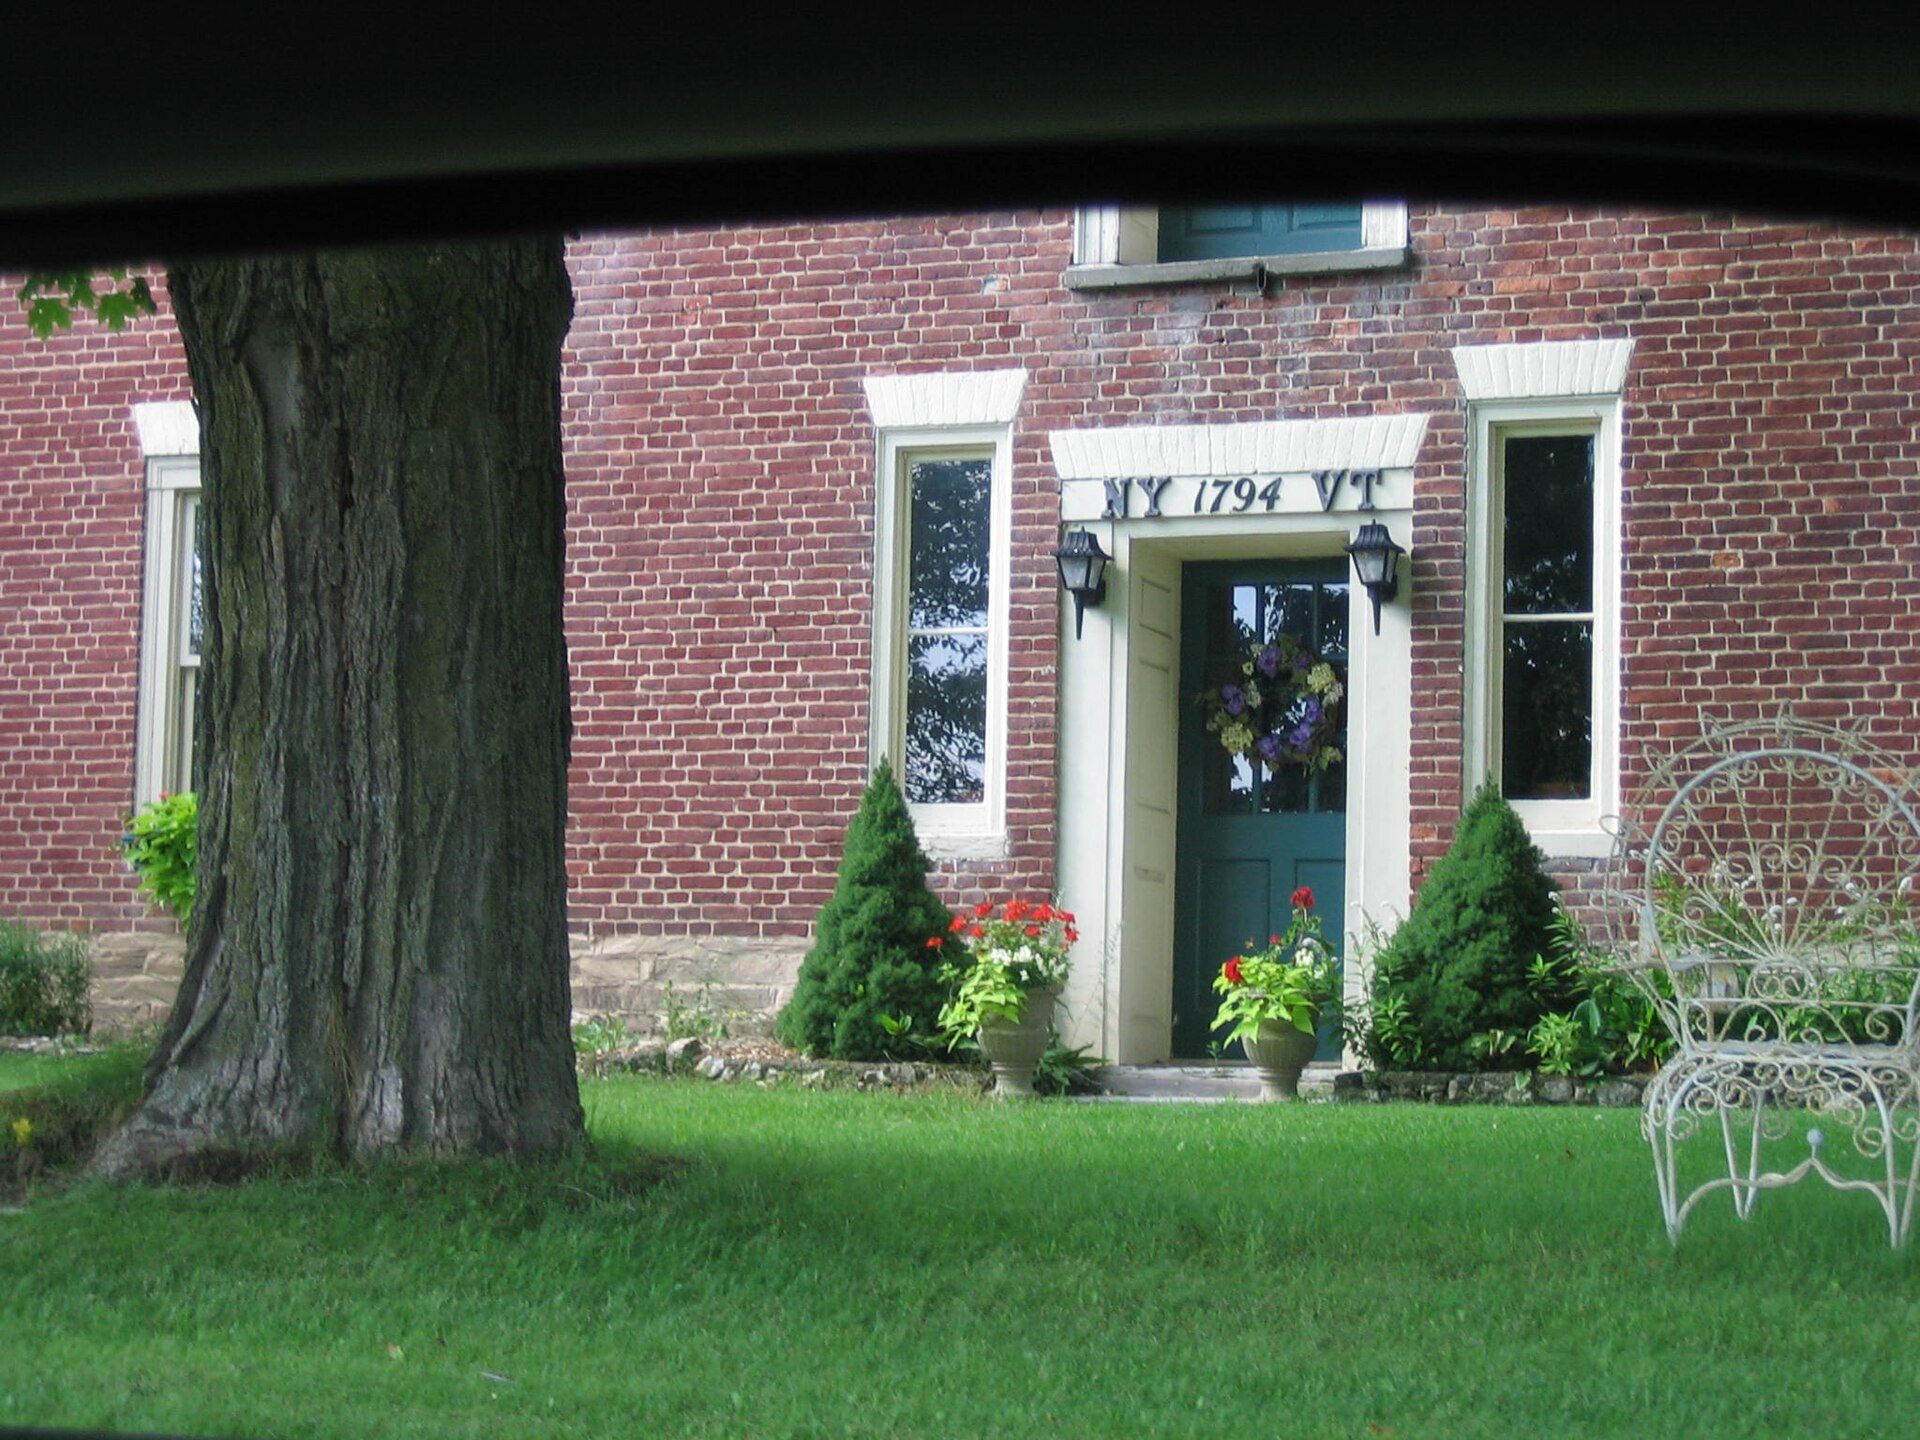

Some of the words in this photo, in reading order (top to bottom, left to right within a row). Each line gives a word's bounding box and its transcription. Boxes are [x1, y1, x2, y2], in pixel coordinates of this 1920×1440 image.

[1101, 476, 1172, 518] NY
[1194, 477, 1283, 513] 1794
[1311, 469, 1384, 512] VT
